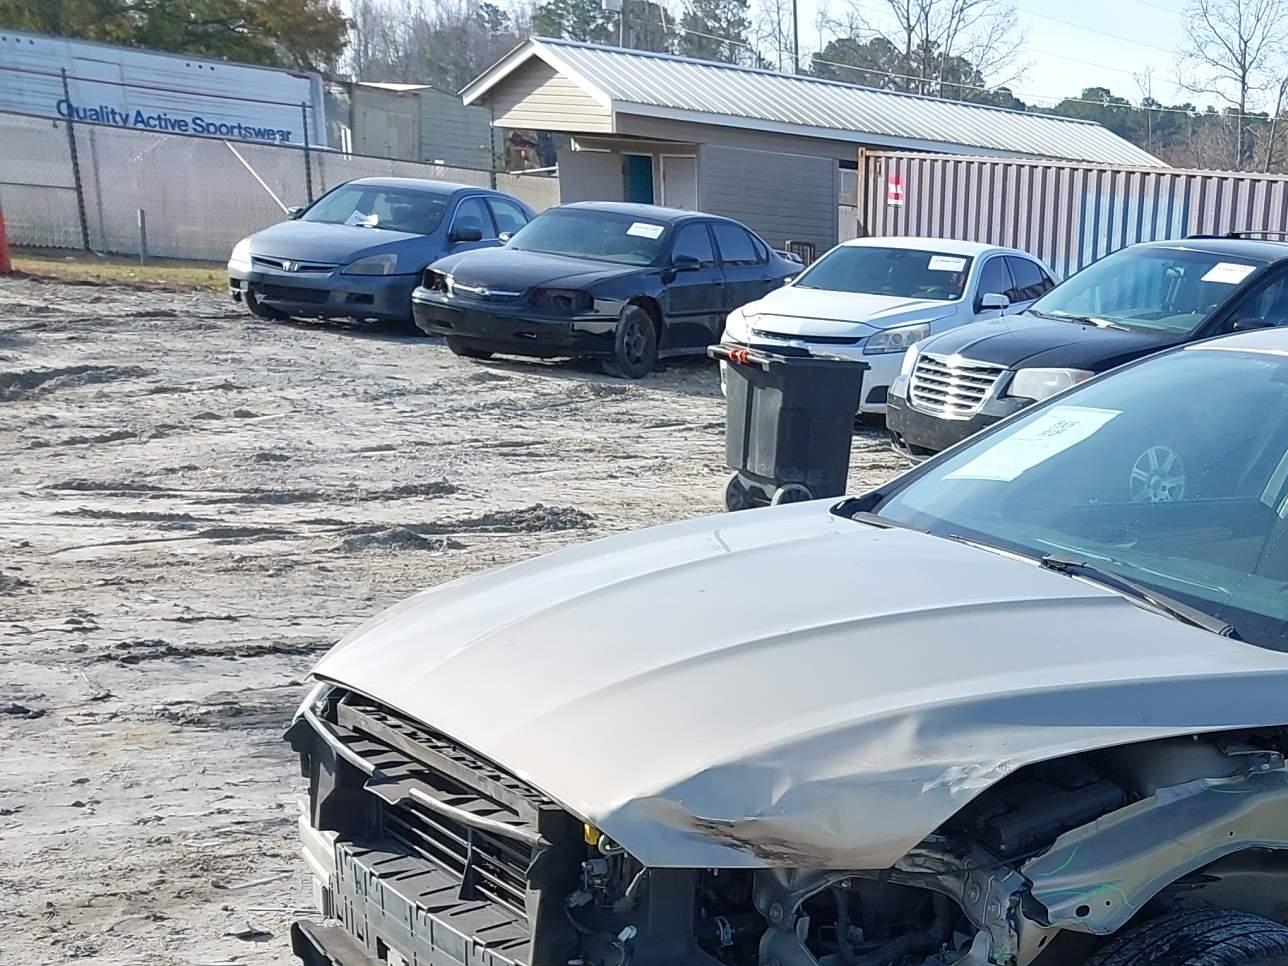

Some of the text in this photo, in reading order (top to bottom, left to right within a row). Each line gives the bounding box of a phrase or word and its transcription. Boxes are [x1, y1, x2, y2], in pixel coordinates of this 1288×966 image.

[56, 98, 292, 142] Quality Active Sportswear
